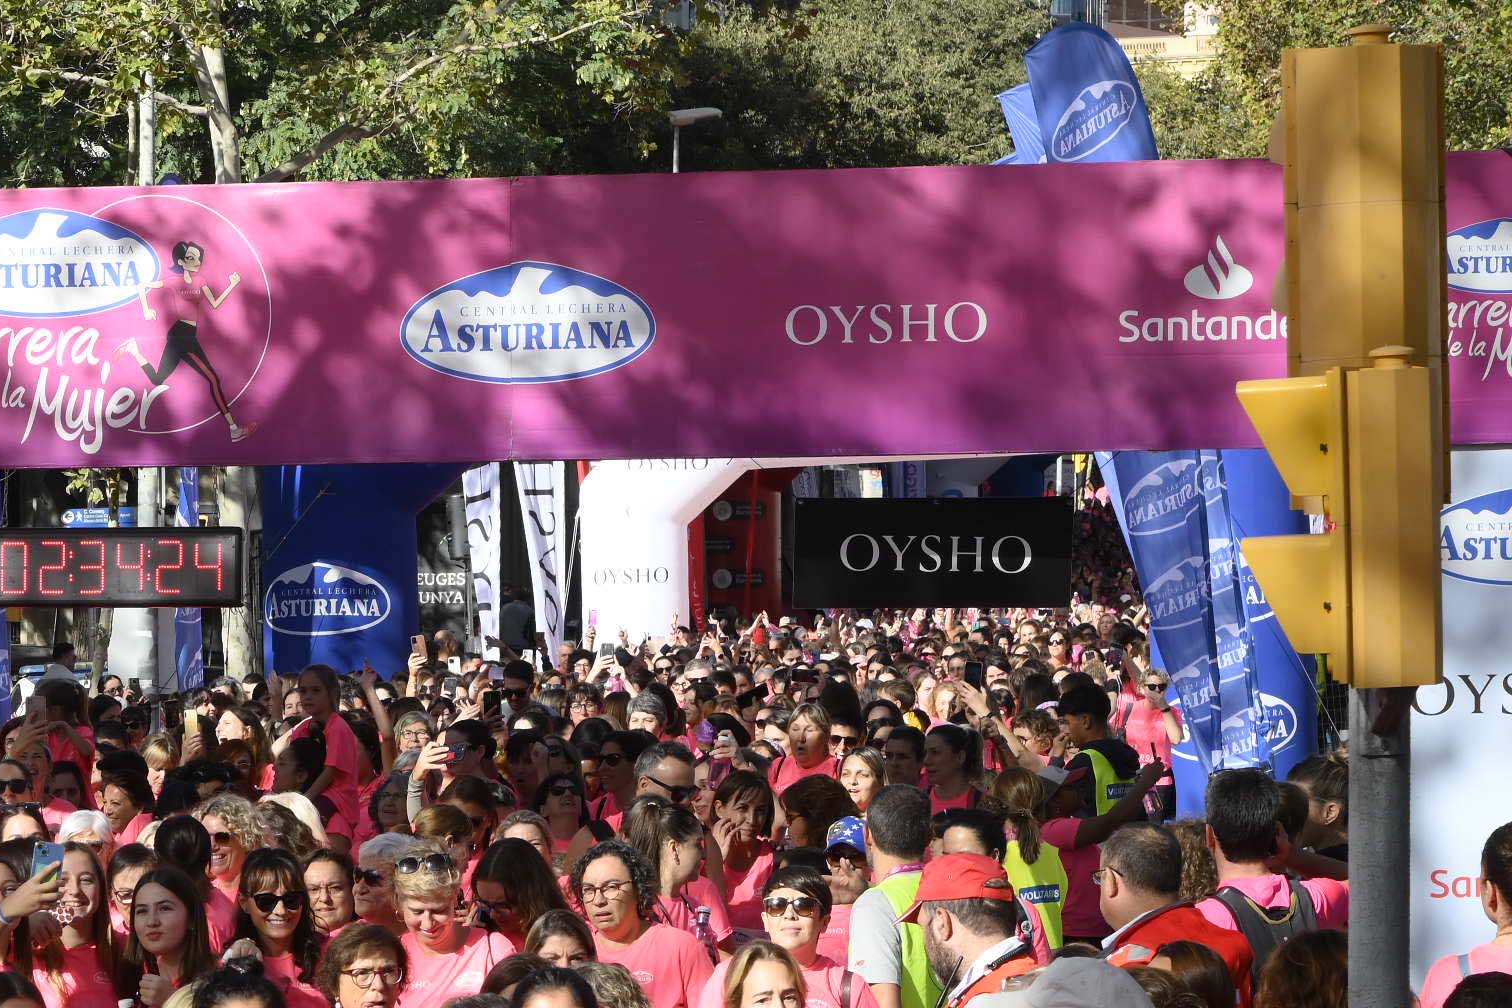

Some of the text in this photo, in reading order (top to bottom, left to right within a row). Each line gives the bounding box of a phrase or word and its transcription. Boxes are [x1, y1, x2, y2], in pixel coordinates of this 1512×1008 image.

[62, 244, 134, 257] LECHERA
[460, 302, 627, 318] CENTRAL LECHERA
[786, 301, 988, 346] OYSHO
[421, 309, 635, 354] ASTURIANA
[1468, 329, 1487, 357] la
[1, 368, 26, 409] la
[20, 359, 169, 454] Mujer
[0, 540, 223, 595] 02:34:24
[839, 533, 1033, 574] OYSHO
[593, 566, 670, 584] OYSHO
[270, 589, 381, 621] ASTURIANA
